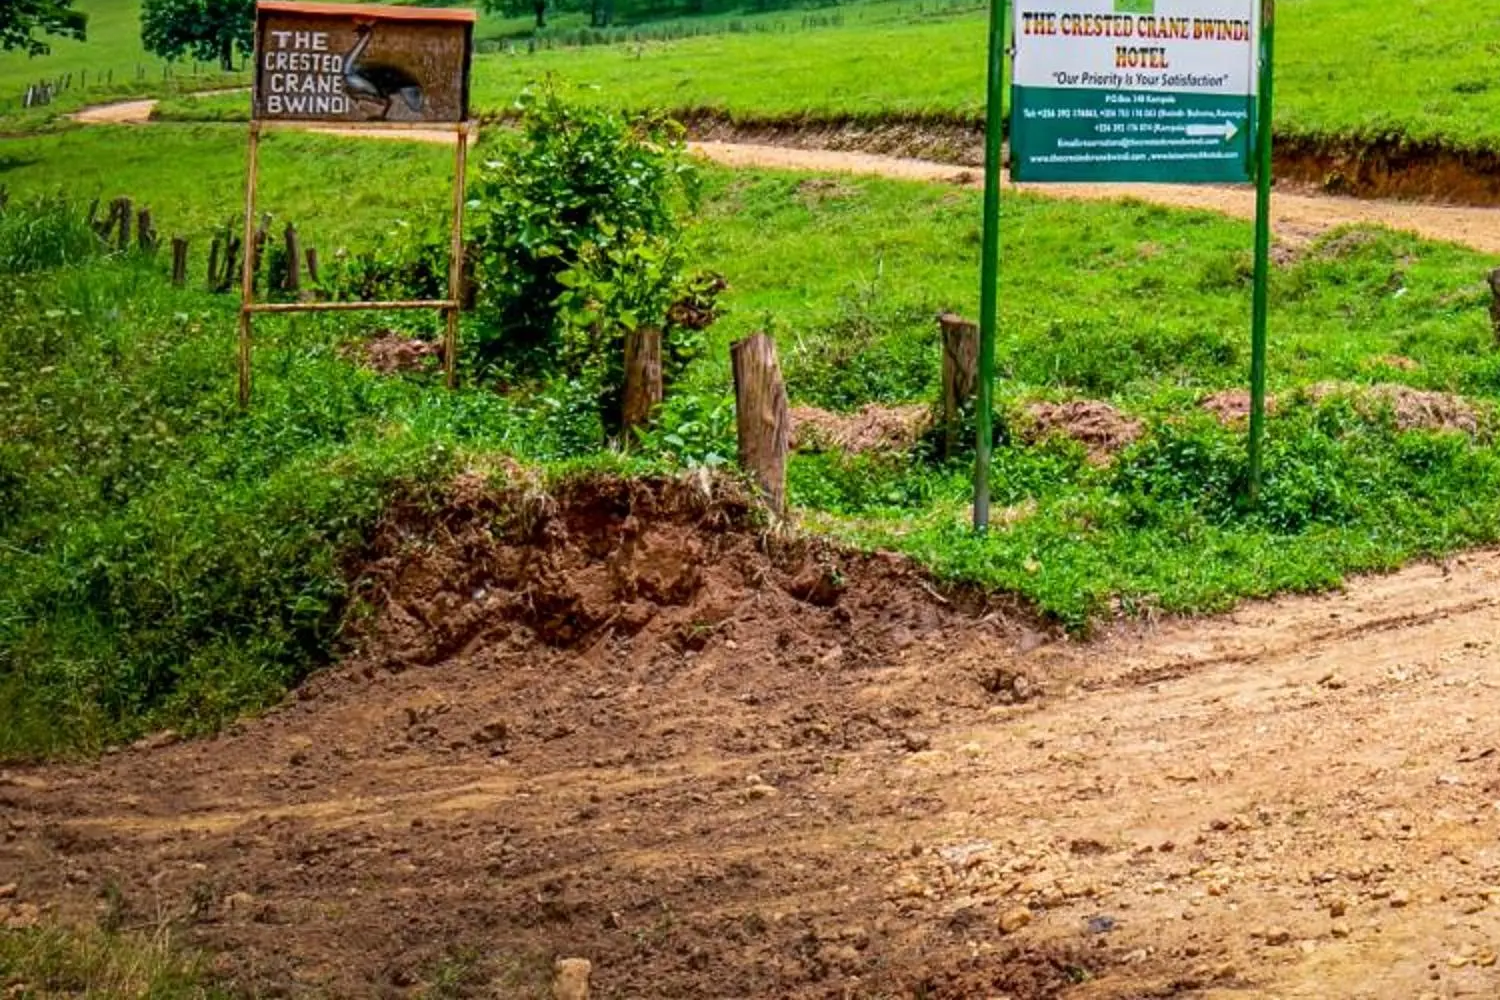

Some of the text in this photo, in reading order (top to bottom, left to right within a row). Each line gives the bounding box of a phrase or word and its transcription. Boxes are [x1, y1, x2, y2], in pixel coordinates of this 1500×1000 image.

[1023, 11, 1250, 41] THE CRESTED CRANE BWINDI
[271, 30, 329, 51] THE
[265, 52, 343, 74] CRESTED
[1115, 46, 1169, 68] HOTEL
[271, 73, 343, 95] CRANE
[1081, 71, 1123, 87] Priority
[1136, 73, 1160, 86] Your
[267, 95, 349, 115] BWINDI
